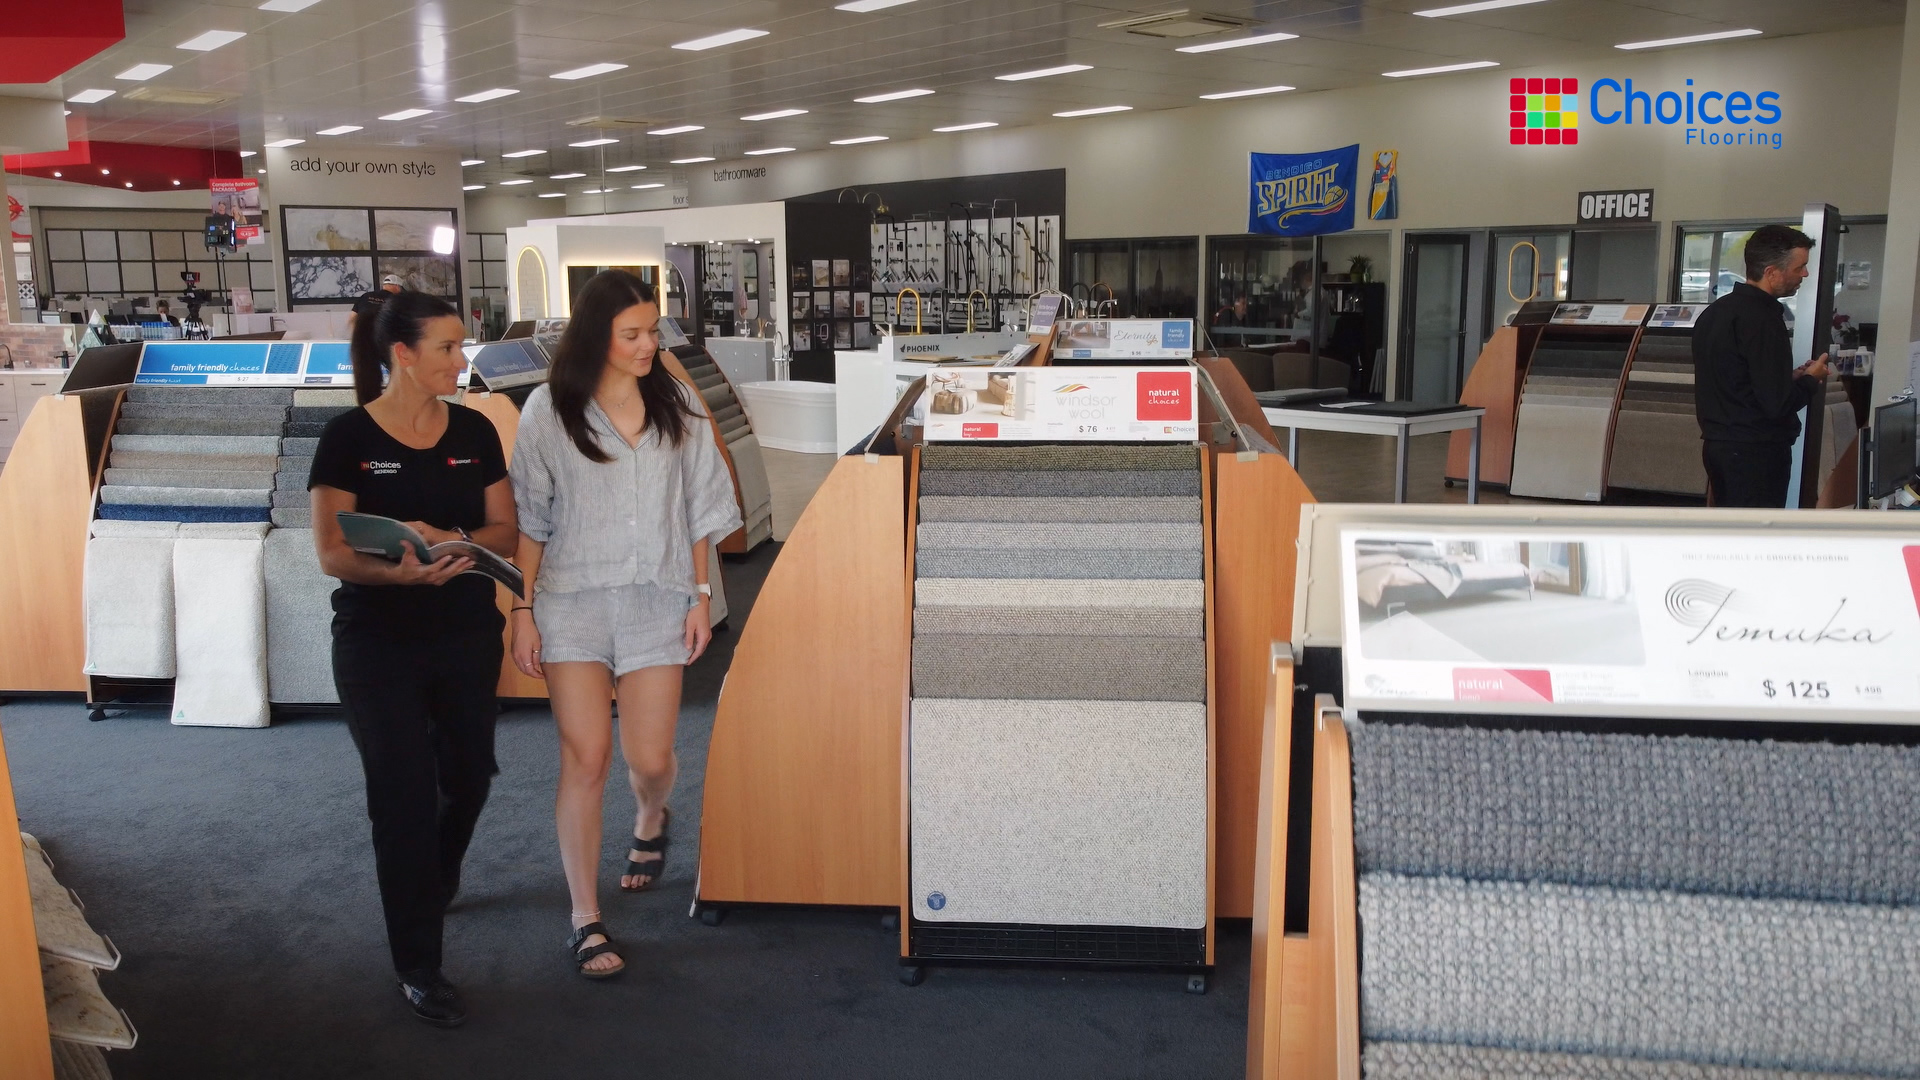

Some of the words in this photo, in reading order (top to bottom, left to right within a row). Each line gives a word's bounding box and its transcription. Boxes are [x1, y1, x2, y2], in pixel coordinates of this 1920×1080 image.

[290, 157, 321, 172] add
[326, 160, 360, 175] your
[365, 161, 398, 174] own
[402, 161, 436, 178] style
[1266, 158, 1323, 180] BENDIGO
[713, 166, 766, 182] bathroomware
[1256, 163, 1339, 217] SPIRIT
[672, 195, 685, 205] floor
[1580, 193, 1650, 219] OFFICE
[1113, 329, 1158, 341] Eternity
[906, 345, 940, 353] PHOENIX
[171, 364, 196, 373] family
[197, 364, 229, 373] friendly
[229, 362, 260, 371] choices
[337, 362, 353, 371] fam
[1148, 389, 1180, 397] natural
[1055, 394, 1117, 407] windsor
[1148, 395, 1180, 405] choices
[1068, 407, 1105, 420] wool
[1079, 425, 1084, 433] $
[1087, 425, 1098, 433] 76
[369, 461, 402, 469] Choices
[1668, 581, 1893, 644] Temuka
[1688, 668, 1729, 678] Langdale
[1458, 678, 1503, 690] natural
[1762, 679, 1777, 698] $
[1785, 680, 1830, 699] 125
